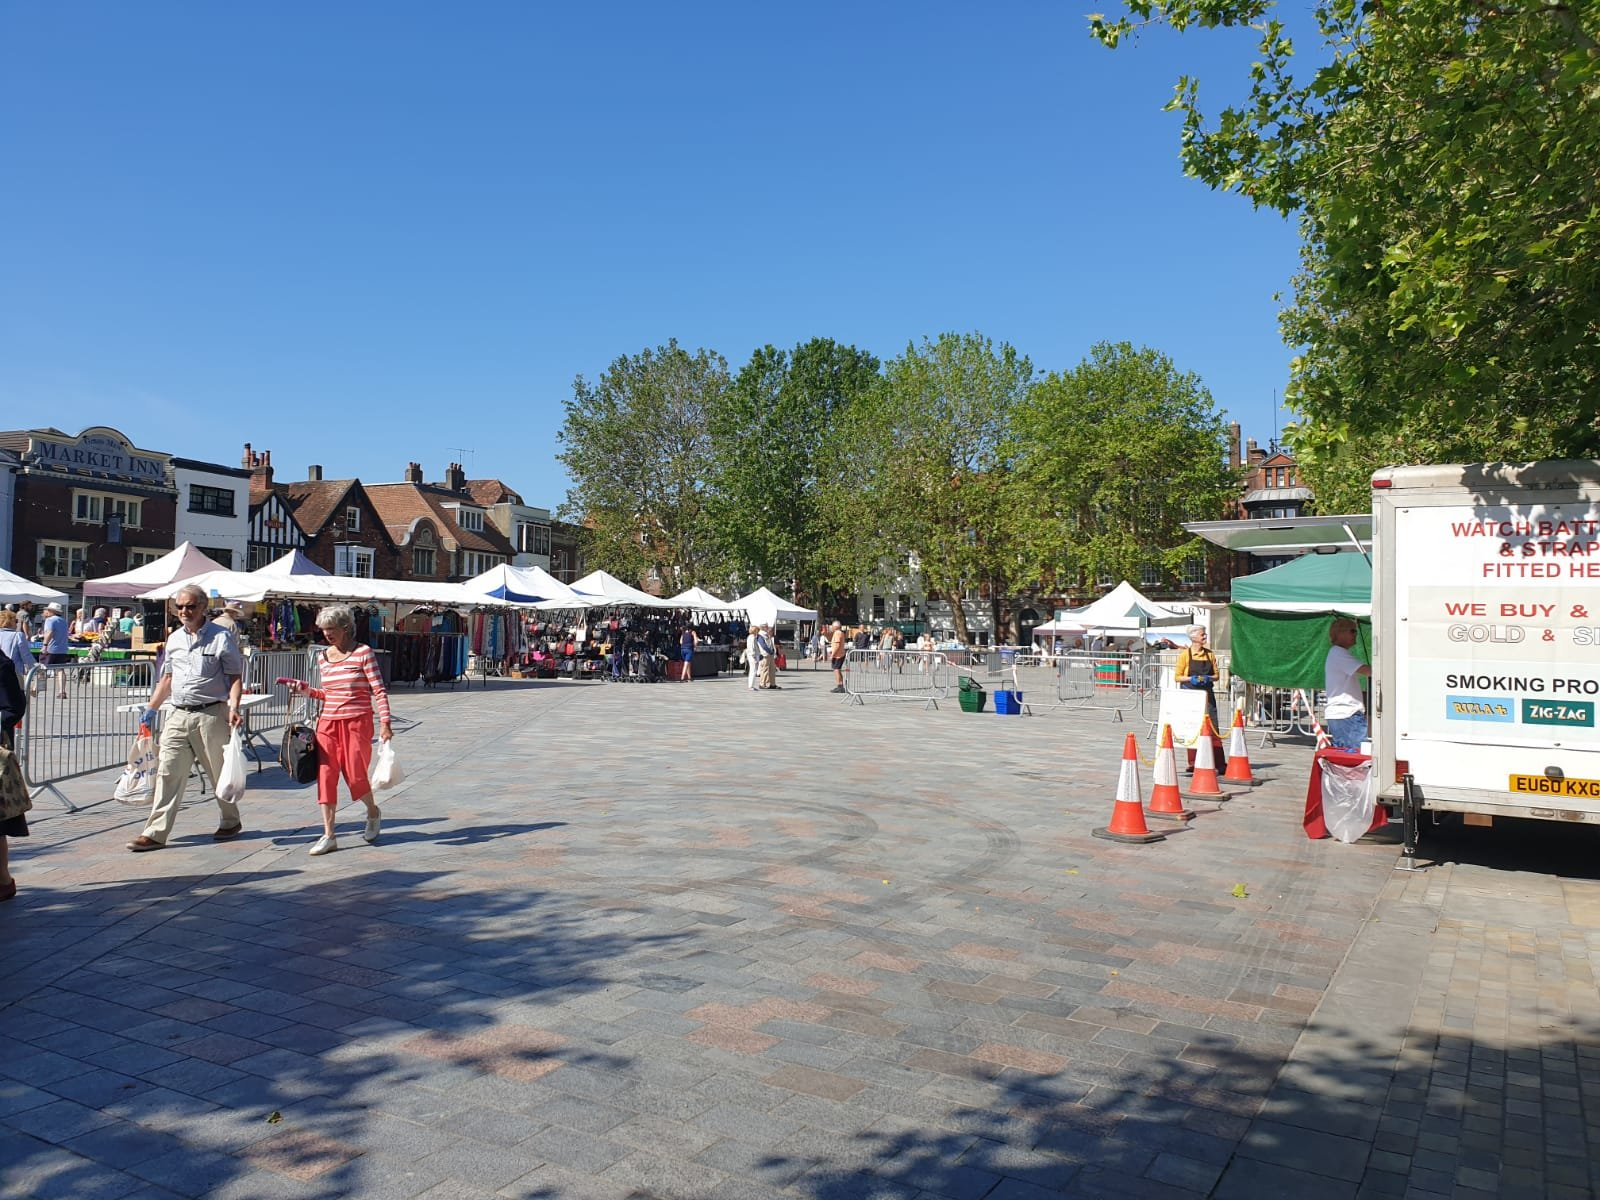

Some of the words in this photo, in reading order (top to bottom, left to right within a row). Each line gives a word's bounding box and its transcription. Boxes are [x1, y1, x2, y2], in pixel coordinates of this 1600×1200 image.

[40, 441, 122, 469] MARKET
[129, 456, 160, 475] INN
[1451, 521, 1530, 537] WATCH
[1538, 520, 1599, 536] BATT
[1499, 542, 1514, 557] &
[1522, 541, 1600, 557] STRAP
[1483, 562, 1561, 578] FITTED
[1569, 562, 1600, 578] HE
[1445, 602, 1487, 616] WE
[1500, 603, 1556, 617] BUY
[1570, 604, 1589, 618] &
[1447, 624, 1525, 643] GOLD
[1542, 628, 1555, 642] &
[1446, 674, 1544, 692] SMOKING
[1552, 678, 1599, 695] PRO
[1516, 776, 1561, 793] EU60
[1566, 780, 1600, 796] KXG
